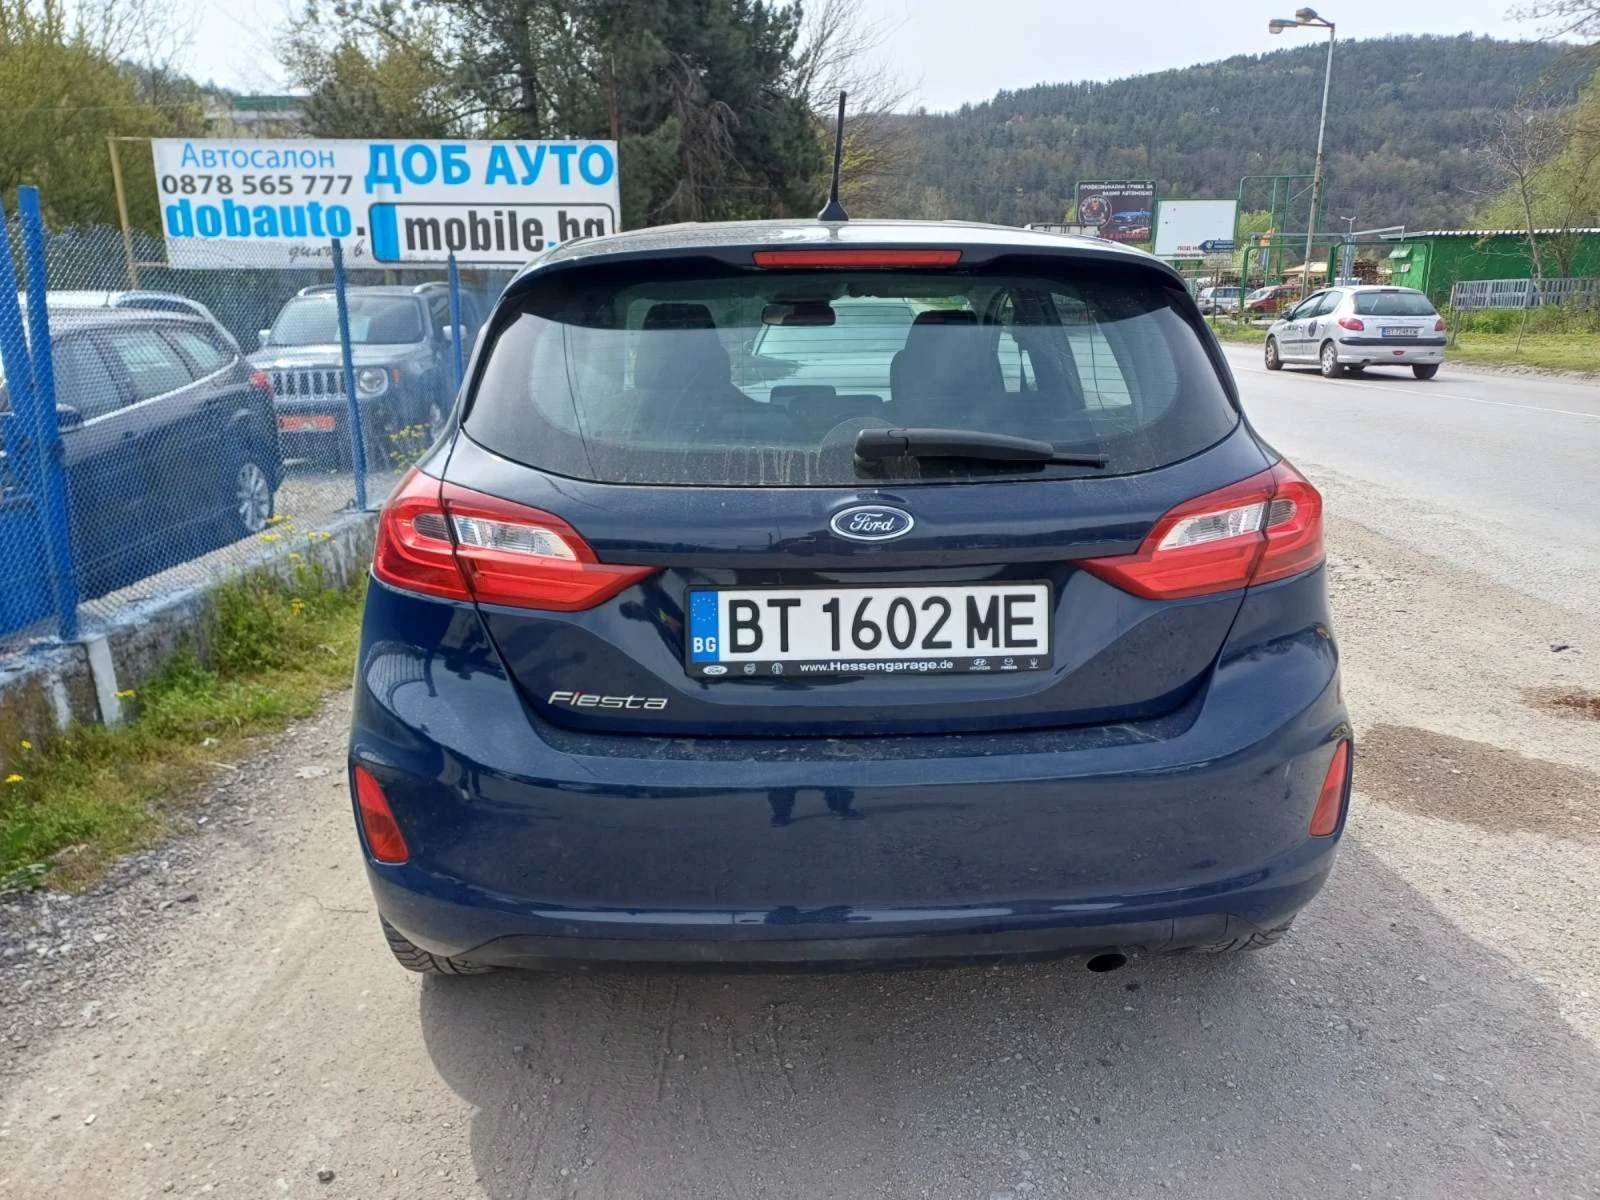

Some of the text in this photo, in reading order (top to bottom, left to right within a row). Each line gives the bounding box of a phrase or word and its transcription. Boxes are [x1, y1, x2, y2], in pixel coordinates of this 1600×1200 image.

[182, 143, 335, 168] Автосалон
[364, 144, 614, 194] ДОБ АУТО
[161, 174, 354, 196] 0878 565 777
[849, 512, 896, 532] Ford
[729, 594, 1037, 653] BT 1602 ME
[693, 637, 717, 653] BG
[800, 661, 953, 672] www.Hessengarage.de
[547, 691, 669, 710] Fiesta
